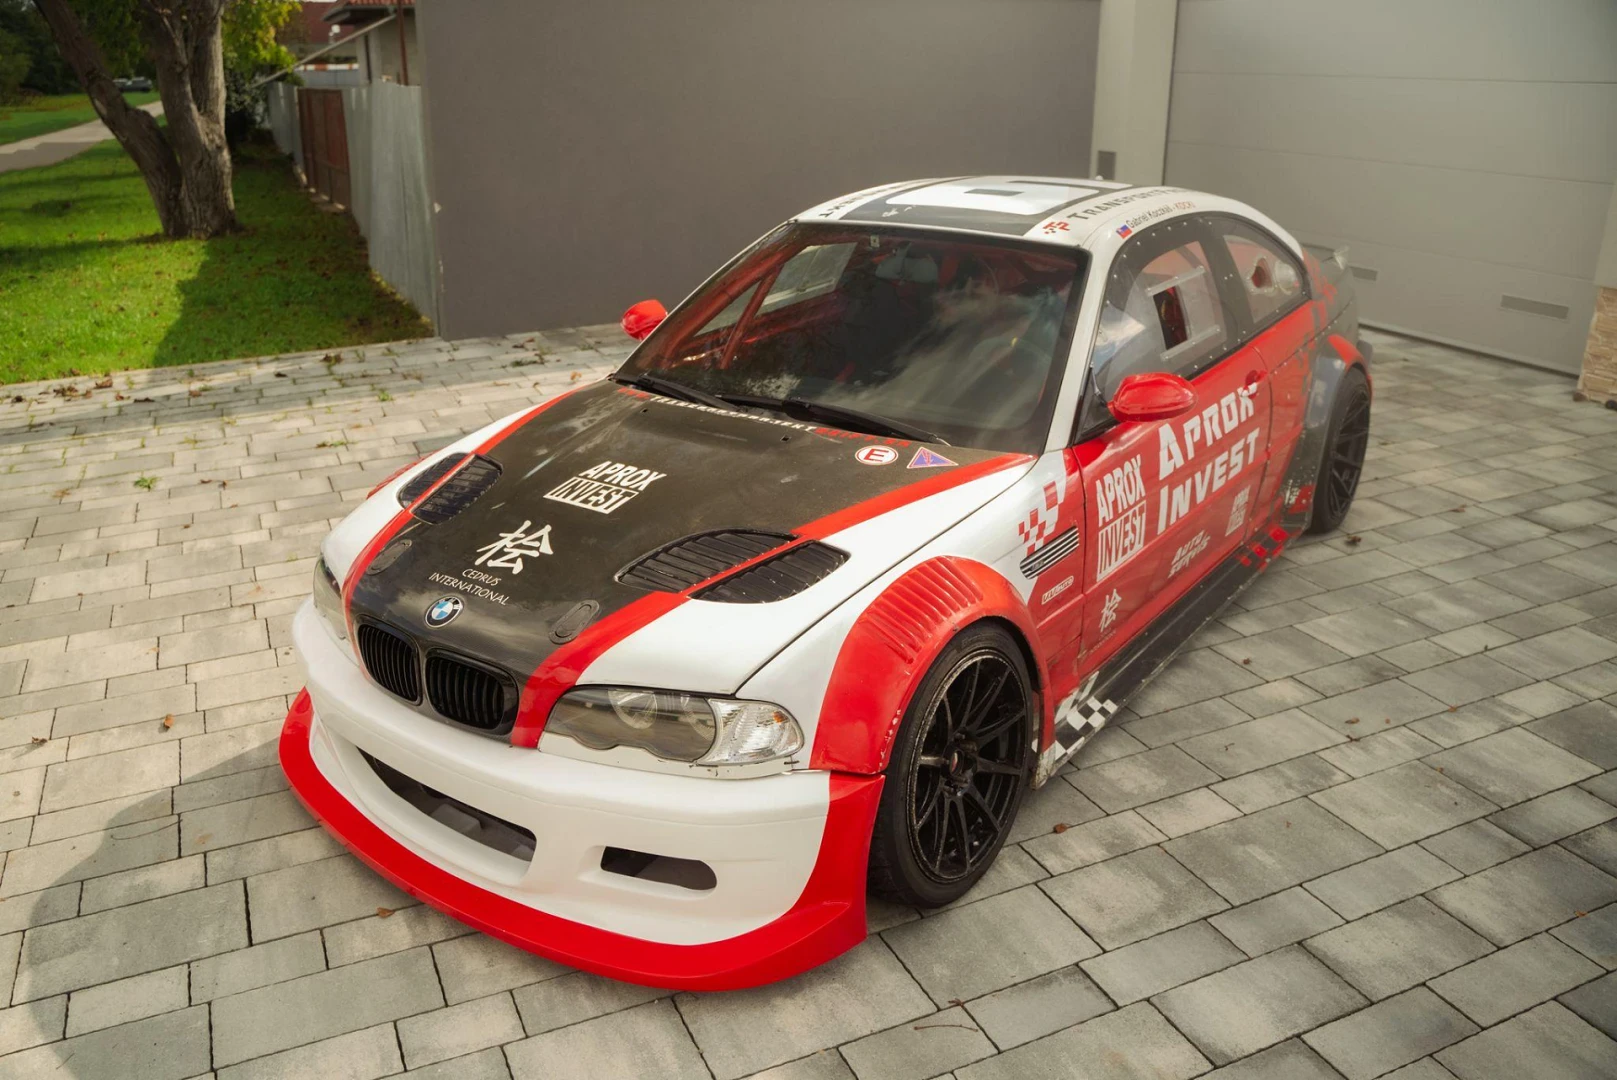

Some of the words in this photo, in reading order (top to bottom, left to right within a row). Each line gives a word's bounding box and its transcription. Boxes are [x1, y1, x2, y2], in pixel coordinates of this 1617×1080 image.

[1158, 382, 1258, 481] APROX
[863, 448, 889, 462] E
[578, 460, 667, 491] APROX
[1095, 454, 1146, 527] APROX
[1157, 427, 1260, 535] INVEST
[546, 477, 638, 513] INVEST
[1098, 503, 1146, 578] INVEST
[428, 571, 510, 606] INTERNATIONAL
[461, 567, 502, 586] CEDRUS
